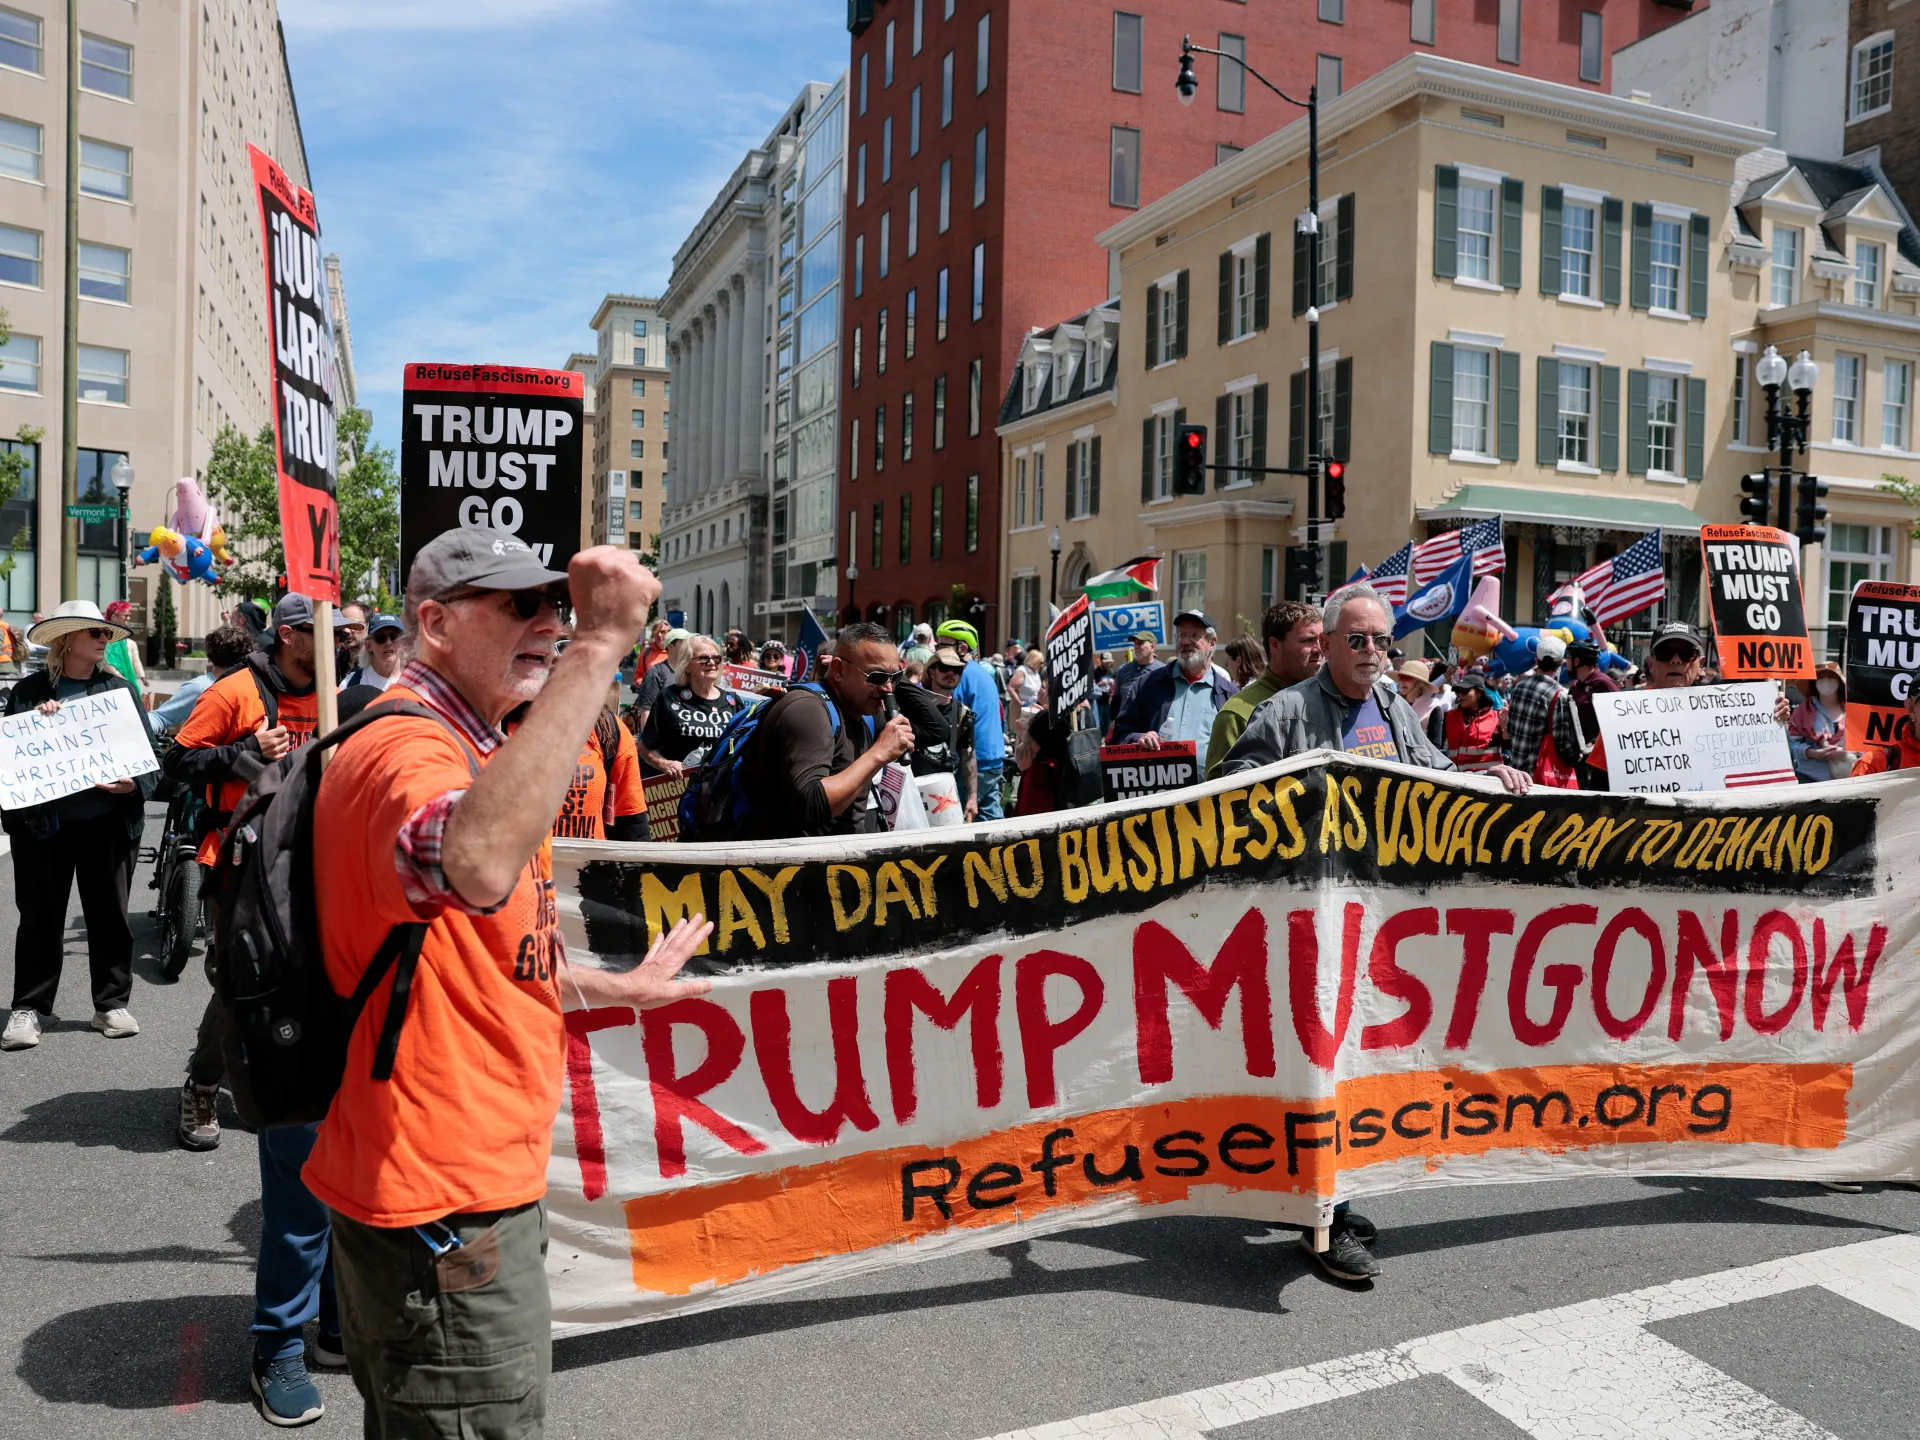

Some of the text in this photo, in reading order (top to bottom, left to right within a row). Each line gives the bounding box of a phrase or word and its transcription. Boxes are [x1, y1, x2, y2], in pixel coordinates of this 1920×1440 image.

[416, 366, 571, 388] RefuseFascism.org
[413, 404, 574, 447] TRUMP
[429, 450, 556, 491] MUST
[69, 507, 105, 517] Vermont
[458, 495, 524, 535] GO
[1707, 545, 1793, 573] TRUMP
[1722, 574, 1790, 601] MUST
[1095, 606, 1156, 634] NOPE
[1746, 603, 1781, 631] GO
[1048, 615, 1089, 660] TRUMP
[1052, 636, 1086, 678] MUST
[1737, 641, 1803, 670] NOW!
[736, 672, 750, 681] NO
[1062, 663, 1080, 689] GO
[1057, 674, 1088, 715] NOW!
[1614, 693, 1756, 717] SAVE OUR DISTRESSED
[2, 696, 118, 738] CHRISTIAN
[678, 709, 733, 726] GOOD
[1715, 713, 1773, 728] DEMOCRACY
[15, 723, 108, 760] AGAINST
[1355, 725, 1387, 743] STOP
[1617, 729, 1682, 750] IMPEACH
[1695, 735, 1728, 753] STEP
[1747, 728, 1784, 746] UNIONS
[1, 749, 114, 787] CHRISTIAN
[1625, 753, 1692, 775] DICTATOR
[1712, 748, 1762, 769] STRIKE!
[10, 759, 156, 806] NATIONALISM
[1107, 763, 1193, 788] TRUMP
[641, 865, 801, 955] MAY
[827, 855, 948, 931] DAY
[963, 839, 1044, 908] NO
[1056, 776, 1307, 903] BUSINESS
[1319, 773, 1367, 855] AS
[1376, 778, 1502, 866] USUAL
[1502, 809, 1544, 865] A
[1543, 812, 1635, 870] DAY
[1625, 816, 1677, 865] TO
[1674, 814, 1833, 875] DEMAND
[564, 901, 1888, 1202] TRUMP MUST GO NOW
